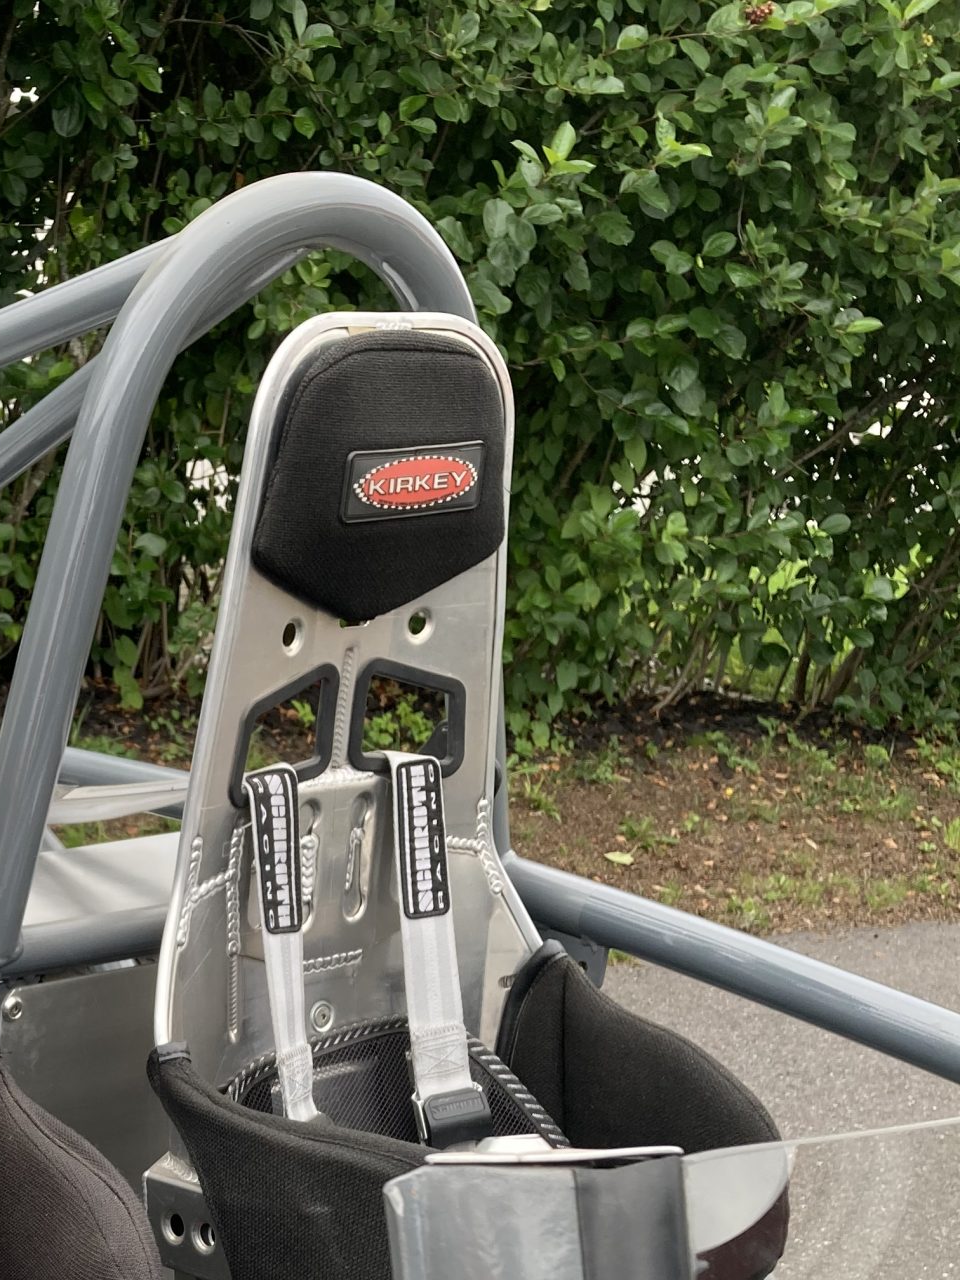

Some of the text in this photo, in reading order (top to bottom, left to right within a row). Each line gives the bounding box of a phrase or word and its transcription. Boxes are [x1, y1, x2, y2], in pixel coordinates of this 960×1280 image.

[368, 471, 468, 497] KIRKEY
[253, 777, 275, 929] RACING
[264, 774, 291, 927] SCHROTH
[410, 765, 434, 912] SCHROTH
[428, 764, 445, 909] RACING
